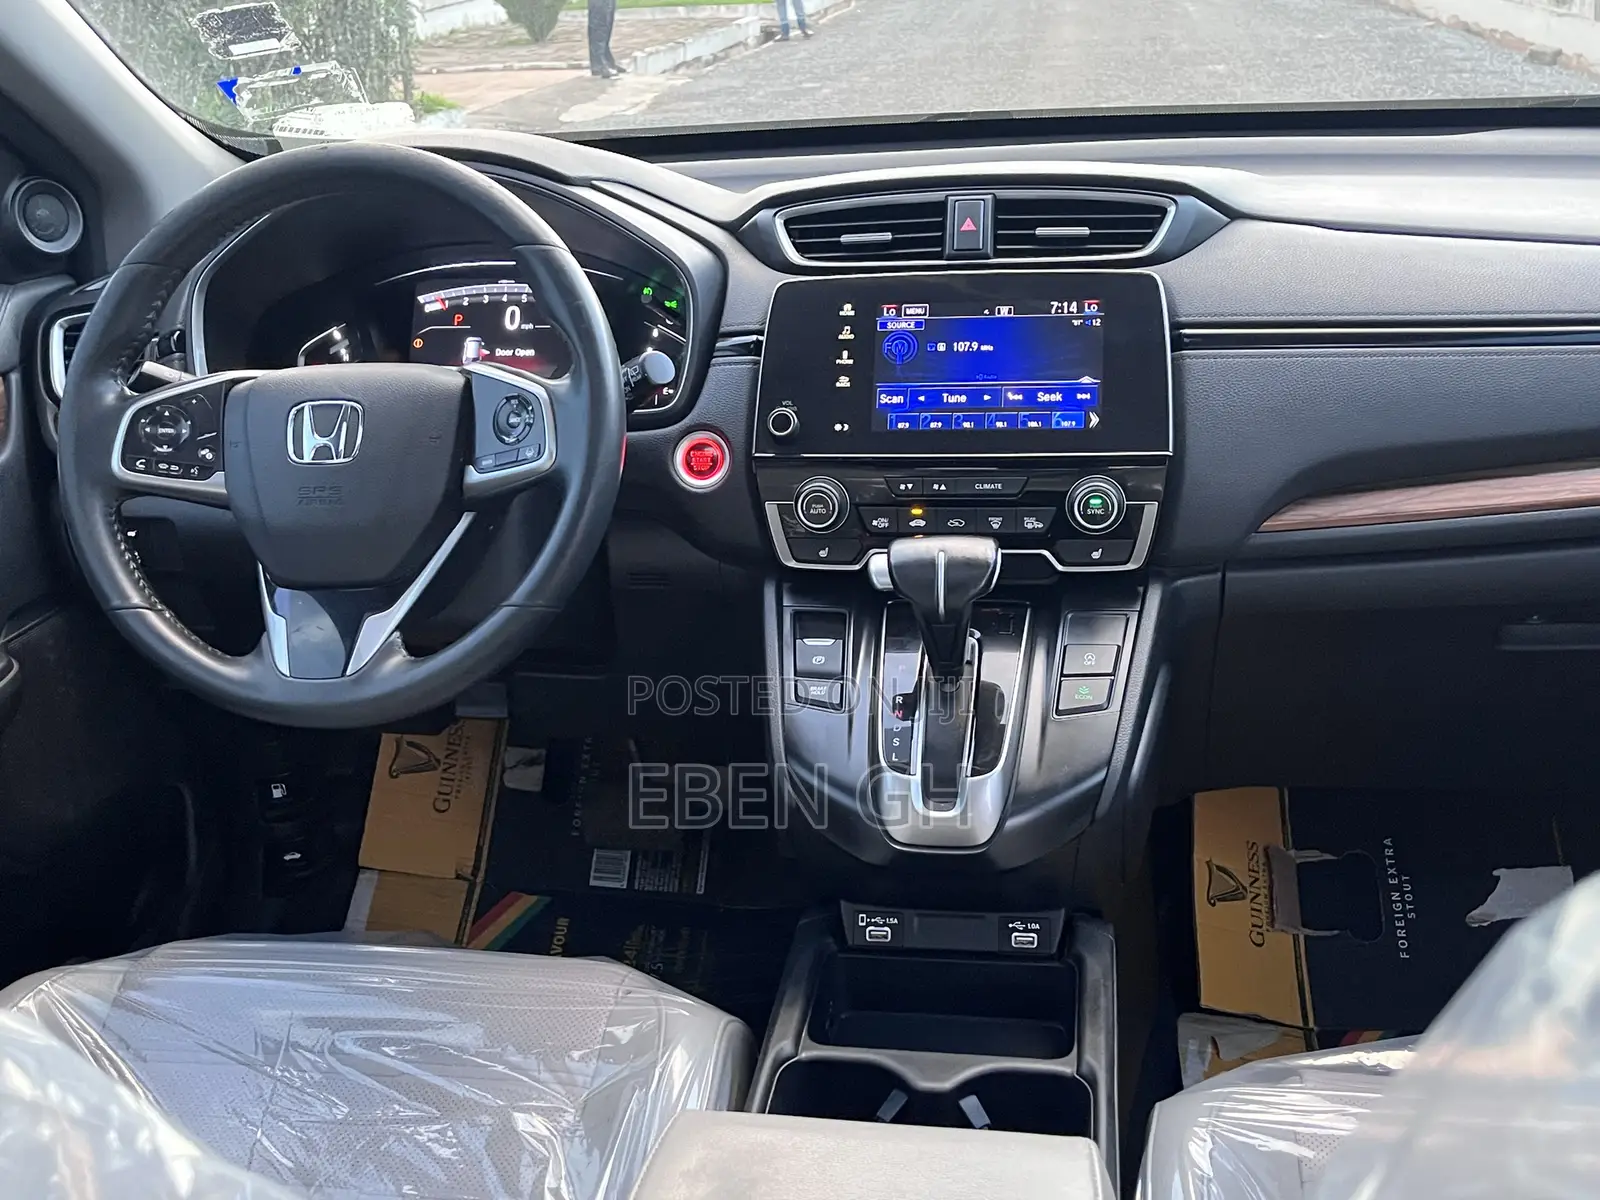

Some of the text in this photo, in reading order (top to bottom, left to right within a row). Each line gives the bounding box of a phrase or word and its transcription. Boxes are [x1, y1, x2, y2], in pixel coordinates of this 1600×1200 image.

[462, 297, 470, 306] 2
[482, 295, 490, 304] 3
[501, 294, 508, 303] 4
[521, 294, 528, 303] 5
[905, 307, 926, 315] MENU
[1050, 300, 1078, 315] 7:14
[454, 314, 464, 326] P
[504, 305, 521, 331] 0
[1092, 318, 1102, 326] 12
[886, 321, 916, 329] SOURCE
[952, 341, 979, 352] 107.9
[495, 348, 535, 359] Door Open
[879, 393, 904, 404] Scan
[942, 393, 967, 403] Tune
[1037, 391, 1063, 402] Seek
[974, 482, 1003, 490] CLIMATE
[895, 695, 903, 704] R
[892, 737, 901, 747] S
[892, 752, 900, 761] L
[432, 721, 466, 813] GUINNES
[1247, 840, 1266, 948] GUINNESS
[1383, 838, 1410, 959] FOREIGN EXTRA
[1402, 875, 1416, 919] STOUT
[550, 917, 570, 957] VOUR
